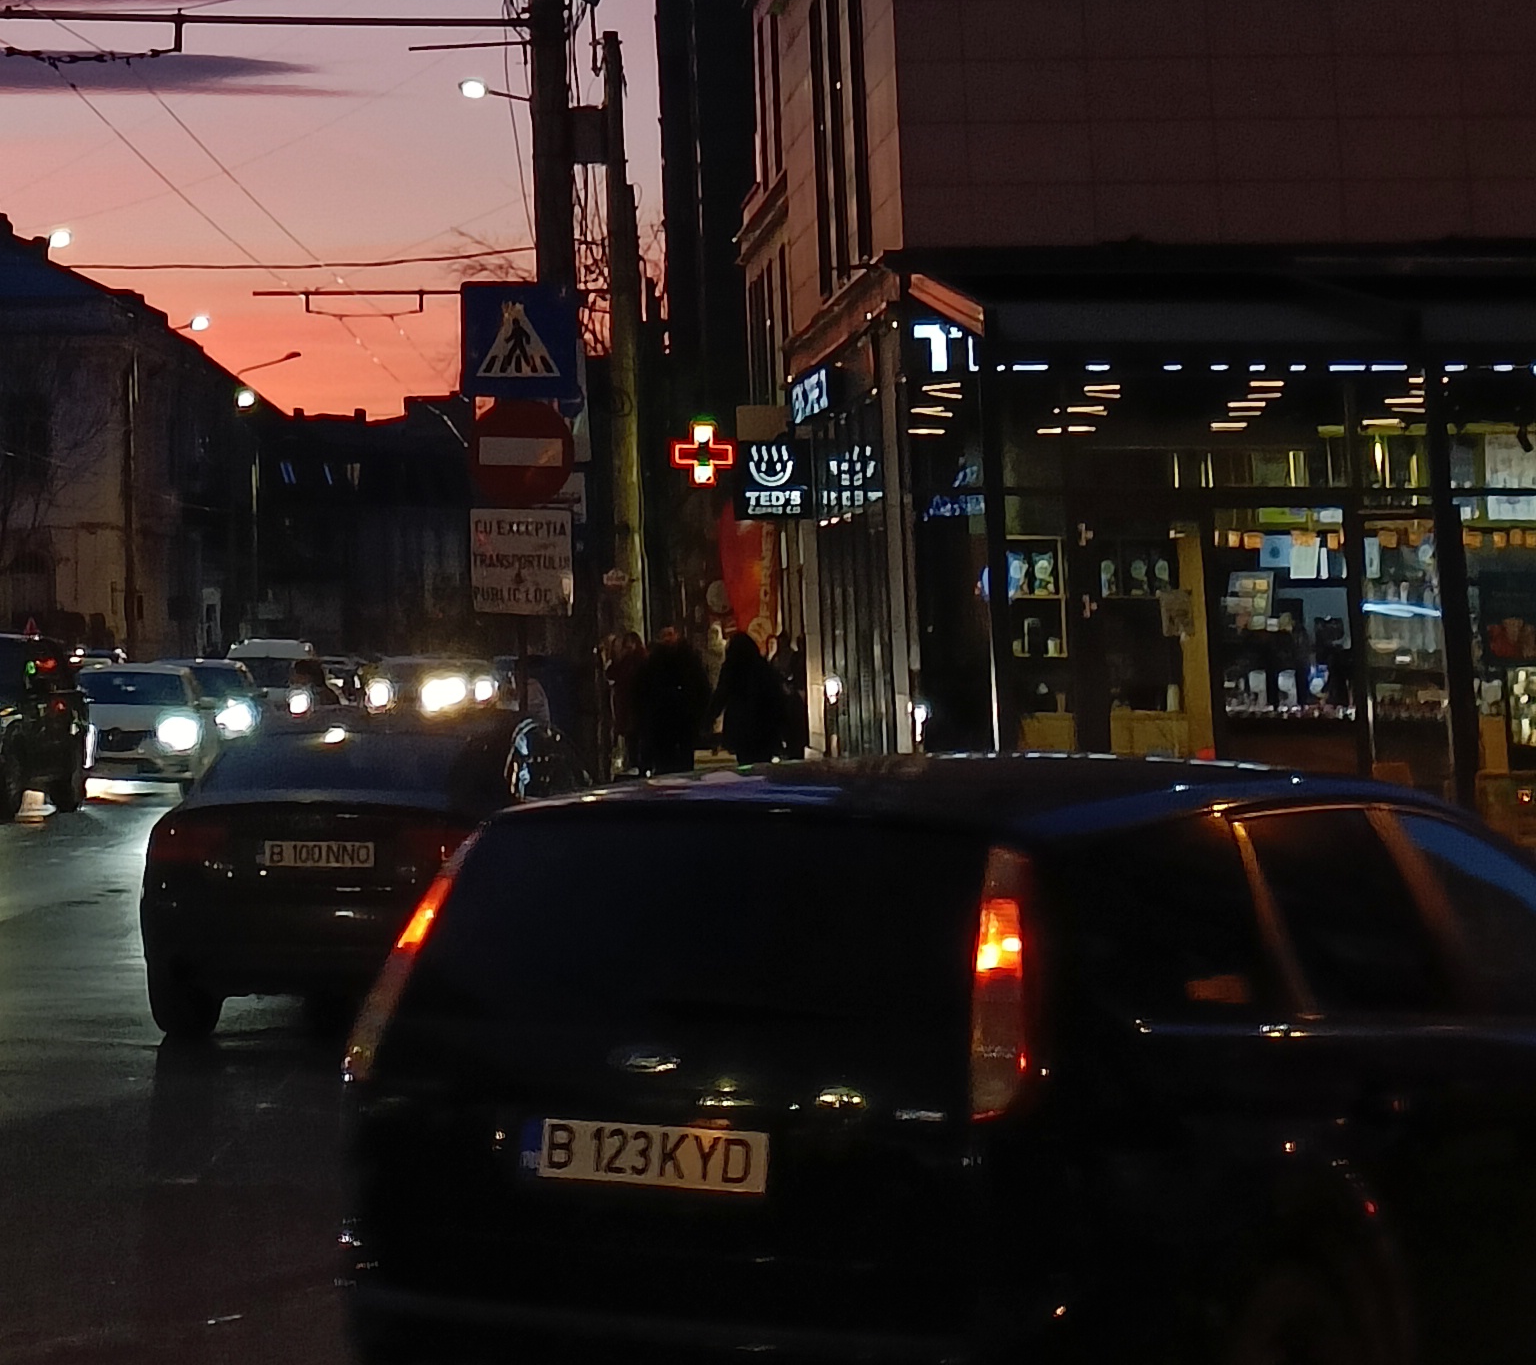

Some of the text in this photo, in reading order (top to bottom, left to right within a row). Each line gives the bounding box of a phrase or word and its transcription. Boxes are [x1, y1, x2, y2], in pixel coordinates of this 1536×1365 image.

[745, 490, 802, 506] TED'S
[474, 519, 493, 536] CU
[473, 585, 521, 604] PUBLIC
[269, 843, 284, 864] B
[547, 1123, 576, 1170] B
